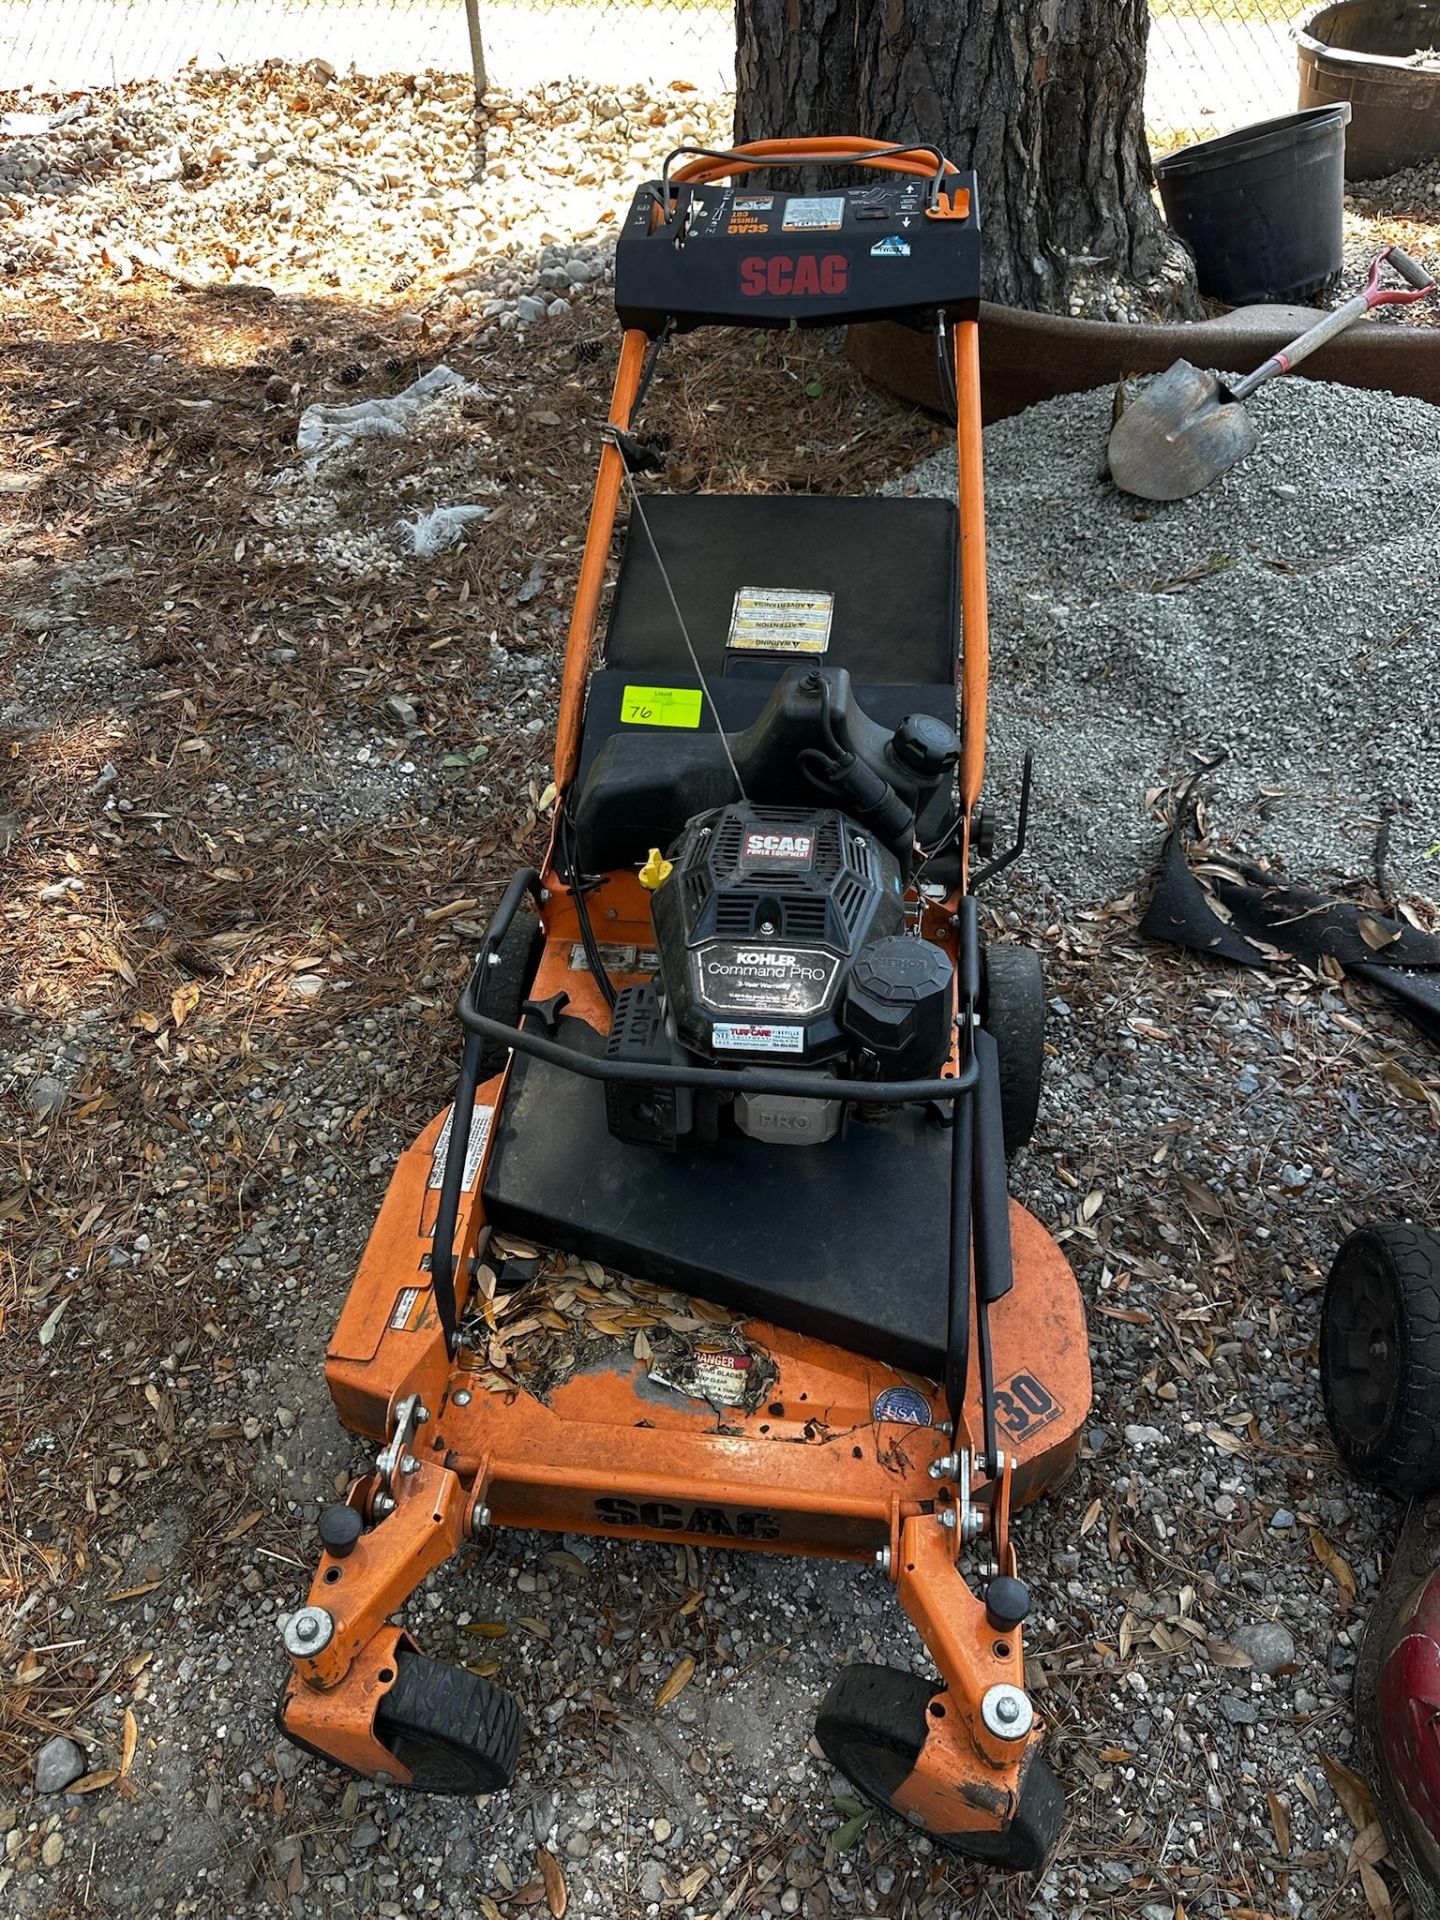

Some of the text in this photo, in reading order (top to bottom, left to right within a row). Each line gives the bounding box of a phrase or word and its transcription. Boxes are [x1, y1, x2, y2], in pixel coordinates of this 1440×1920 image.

[727, 223, 769, 234] SCAG
[740, 255, 848, 296] SCAG
[630, 706, 653, 719] 76
[748, 835, 811, 852] SCAG
[746, 848, 809, 858] POWER EQUIPMENT
[708, 962, 826, 981] Command PRO
[760, 1113, 810, 1129] PRO
[993, 1374, 1052, 1431] 30
[884, 1404, 921, 1426] USA
[594, 1497, 781, 1539] SCAG
